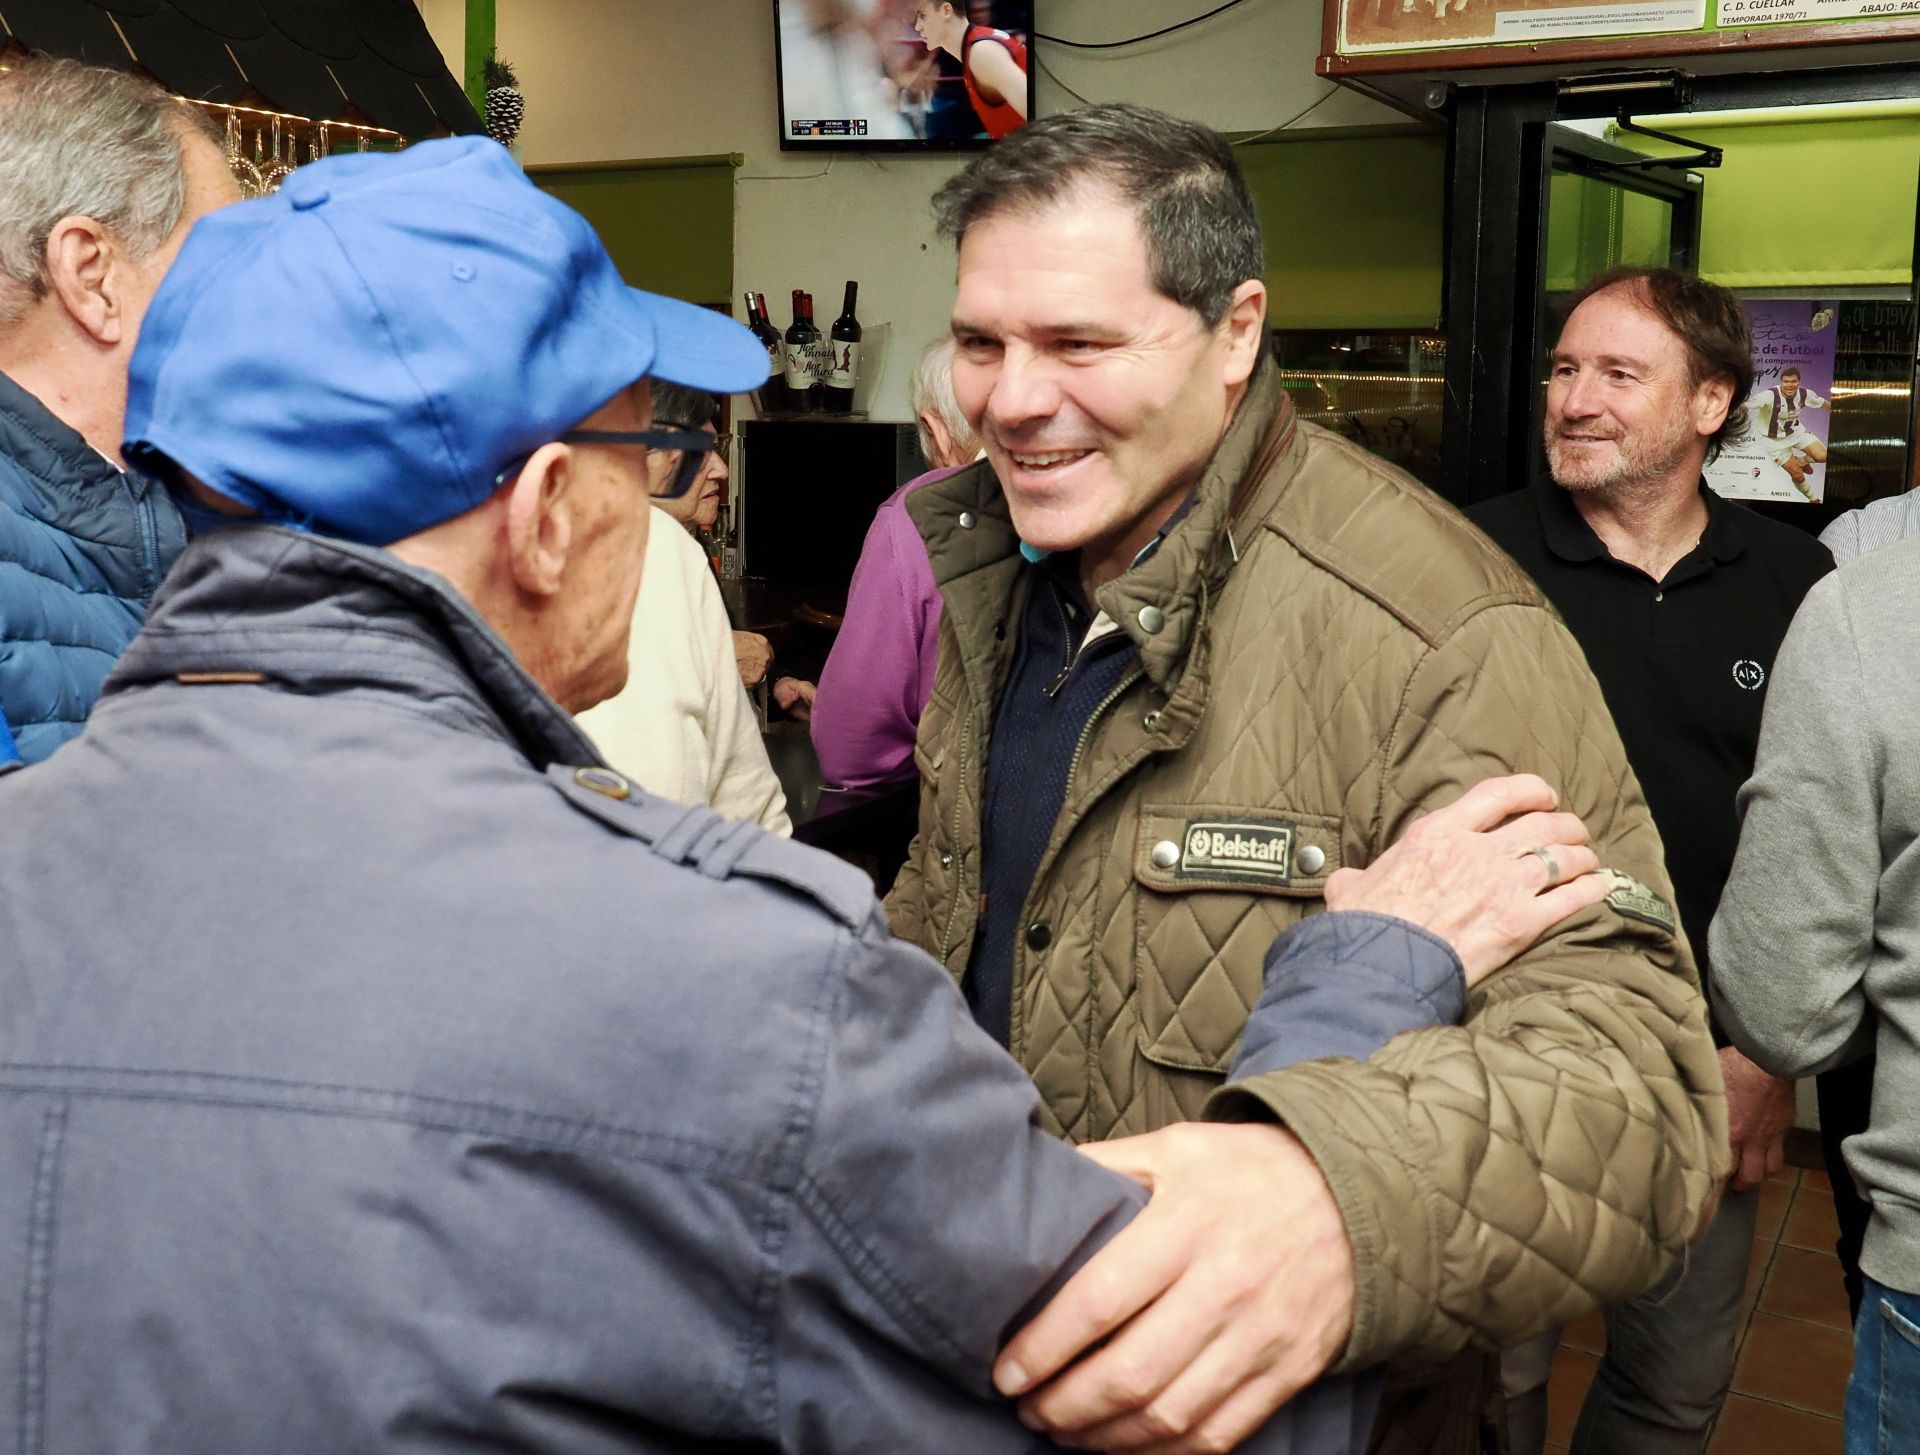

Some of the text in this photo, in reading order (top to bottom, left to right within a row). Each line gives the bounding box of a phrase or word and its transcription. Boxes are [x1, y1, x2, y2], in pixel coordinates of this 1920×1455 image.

[1723, 2, 1732, 12] C.
[1735, 1, 1746, 11] D.
[1860, 3, 1898, 13] ABAJO:
[1722, 11, 1807, 24] TEMPORADA 1970/71
[1762, 344, 1778, 354] de
[1211, 832, 1285, 862] Belstaff
